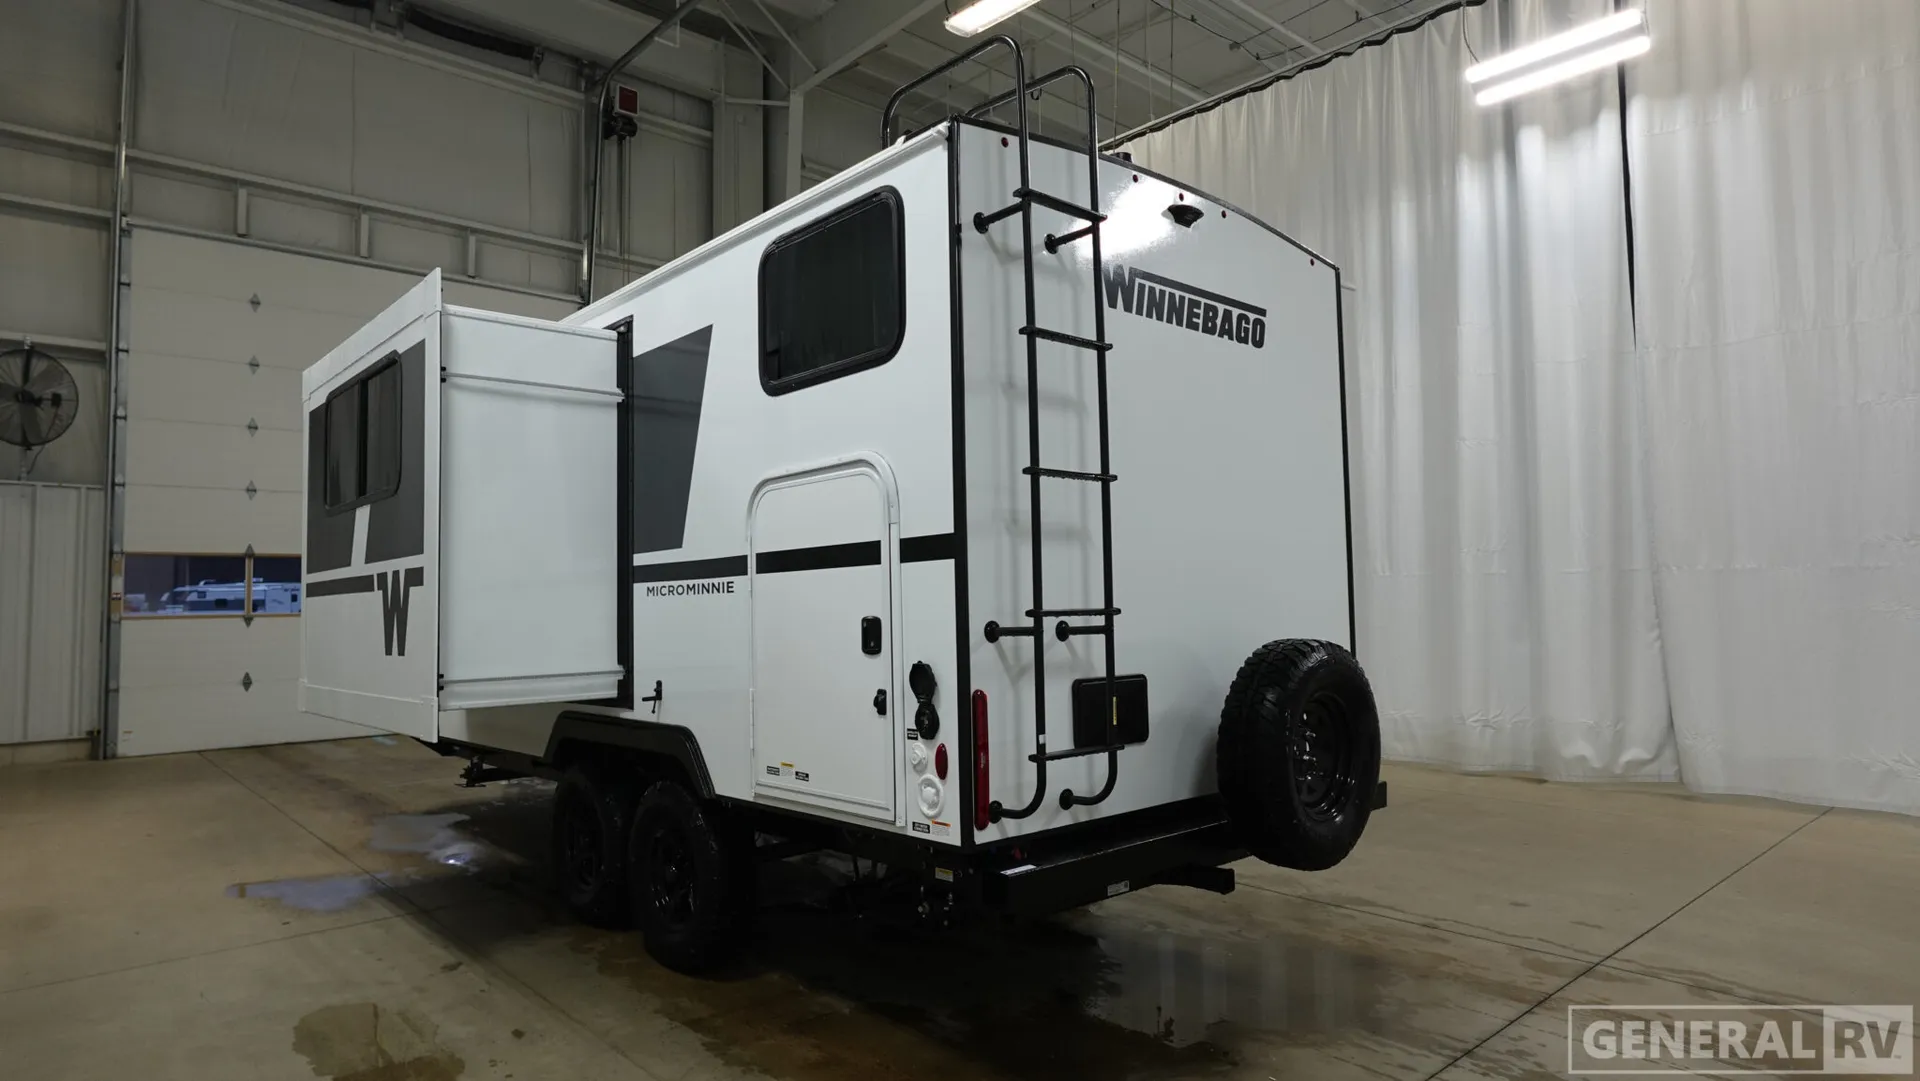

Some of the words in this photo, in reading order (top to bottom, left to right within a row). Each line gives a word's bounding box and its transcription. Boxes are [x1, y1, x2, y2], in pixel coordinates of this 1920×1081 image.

[1101, 264, 1266, 348] WINNEBAGO
[376, 566, 424, 656] W
[646, 581, 735, 597] MICROMINNIE
